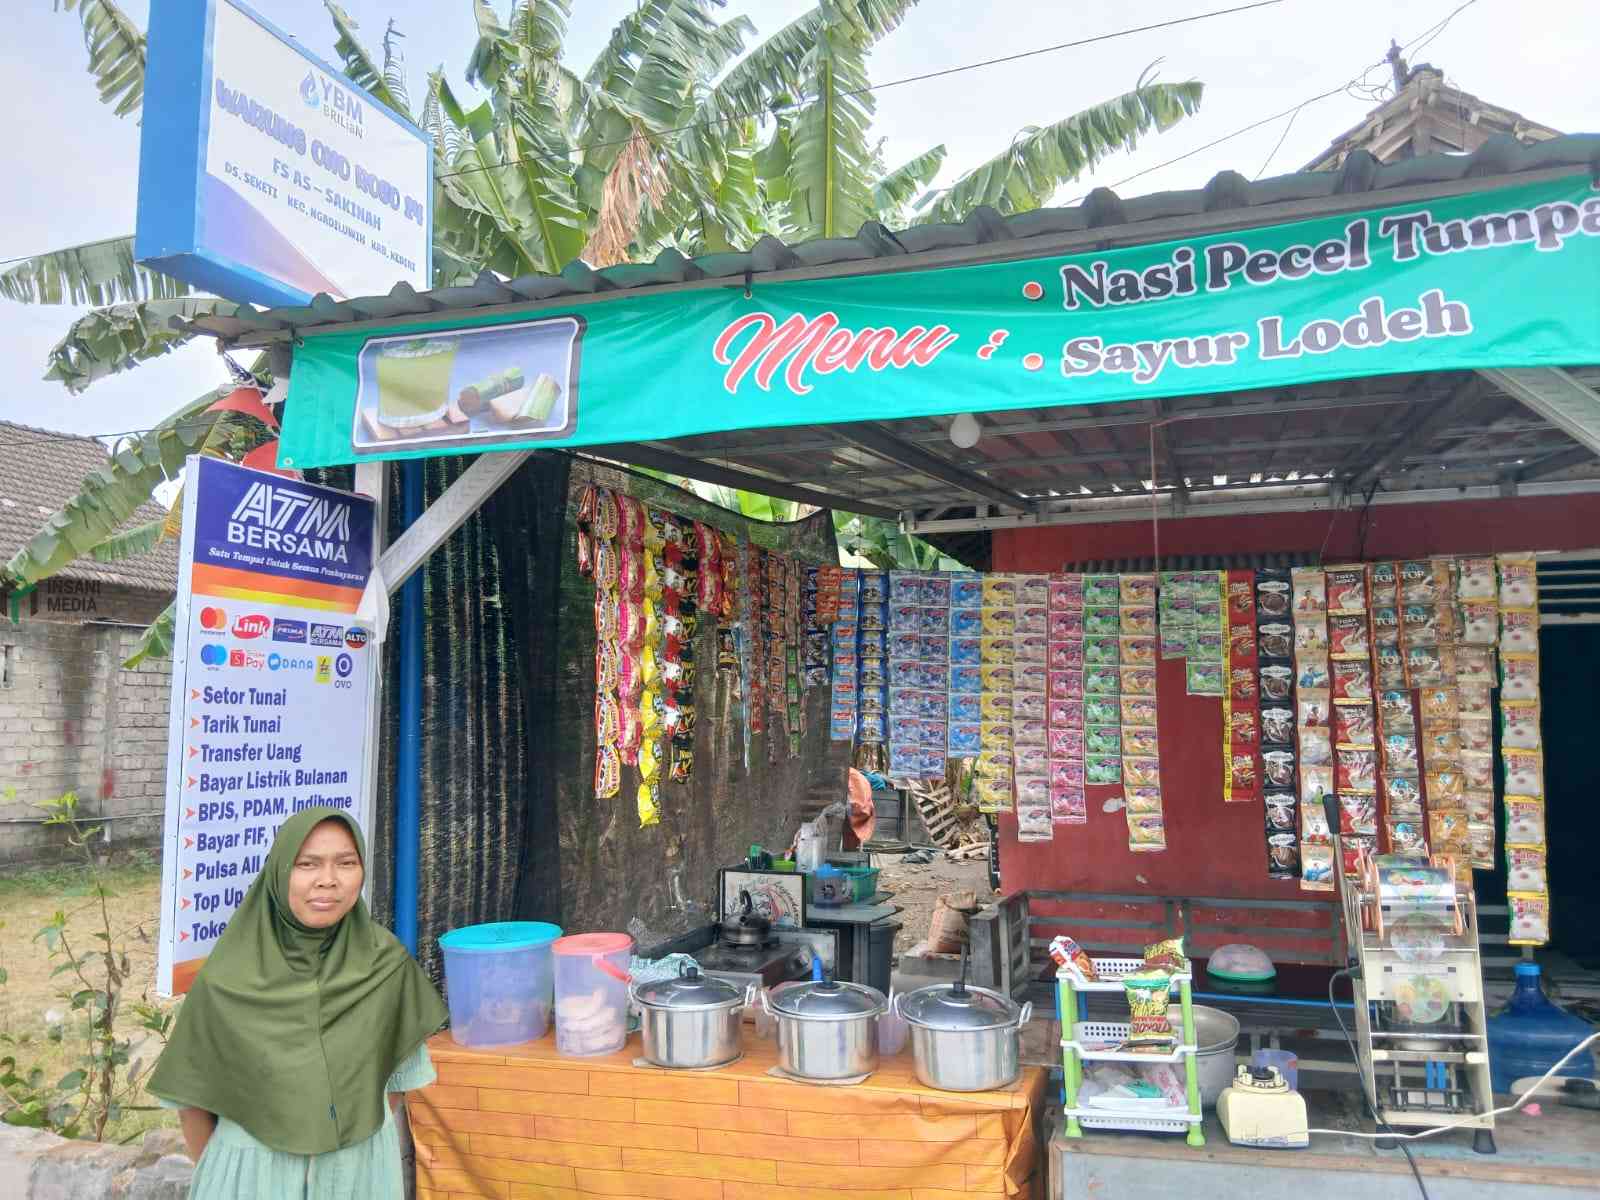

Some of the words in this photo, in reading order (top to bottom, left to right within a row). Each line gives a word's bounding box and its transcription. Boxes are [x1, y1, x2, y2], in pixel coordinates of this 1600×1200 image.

[319, 75, 363, 125] YBM
[1062, 246, 1198, 311] Nasi
[1205, 218, 1372, 292] Pecel
[1061, 332, 1248, 384] Sayur
[1257, 289, 1475, 360] Lodeh
[713, 311, 959, 395] Menu
[231, 482, 351, 542] ATM
[208, 546, 230, 559] Satu
[232, 551, 265, 566] Tempat
[227, 521, 348, 564] BERSAMA
[233, 614, 269, 637] Link
[345, 632, 368, 643] ALTO
[202, 685, 246, 705] Setor
[249, 687, 287, 706] Tunai
[202, 714, 239, 733] Tarik
[243, 715, 281, 733] Tunai
[201, 743, 263, 763] Transfer
[267, 743, 302, 763] Uang
[200, 773, 244, 795] Bayar
[247, 769, 291, 790] Listrik
[295, 768, 348, 786] Bulanan
[198, 801, 239, 823] BPJS,
[243, 797, 288, 818] PDAM,
[197, 832, 241, 854] Bayar
[244, 826, 268, 848] FIF,
[195, 860, 238, 882] Pulsa
[241, 854, 260, 875] All
[193, 892, 220, 913] Top
[224, 887, 244, 909] Up
